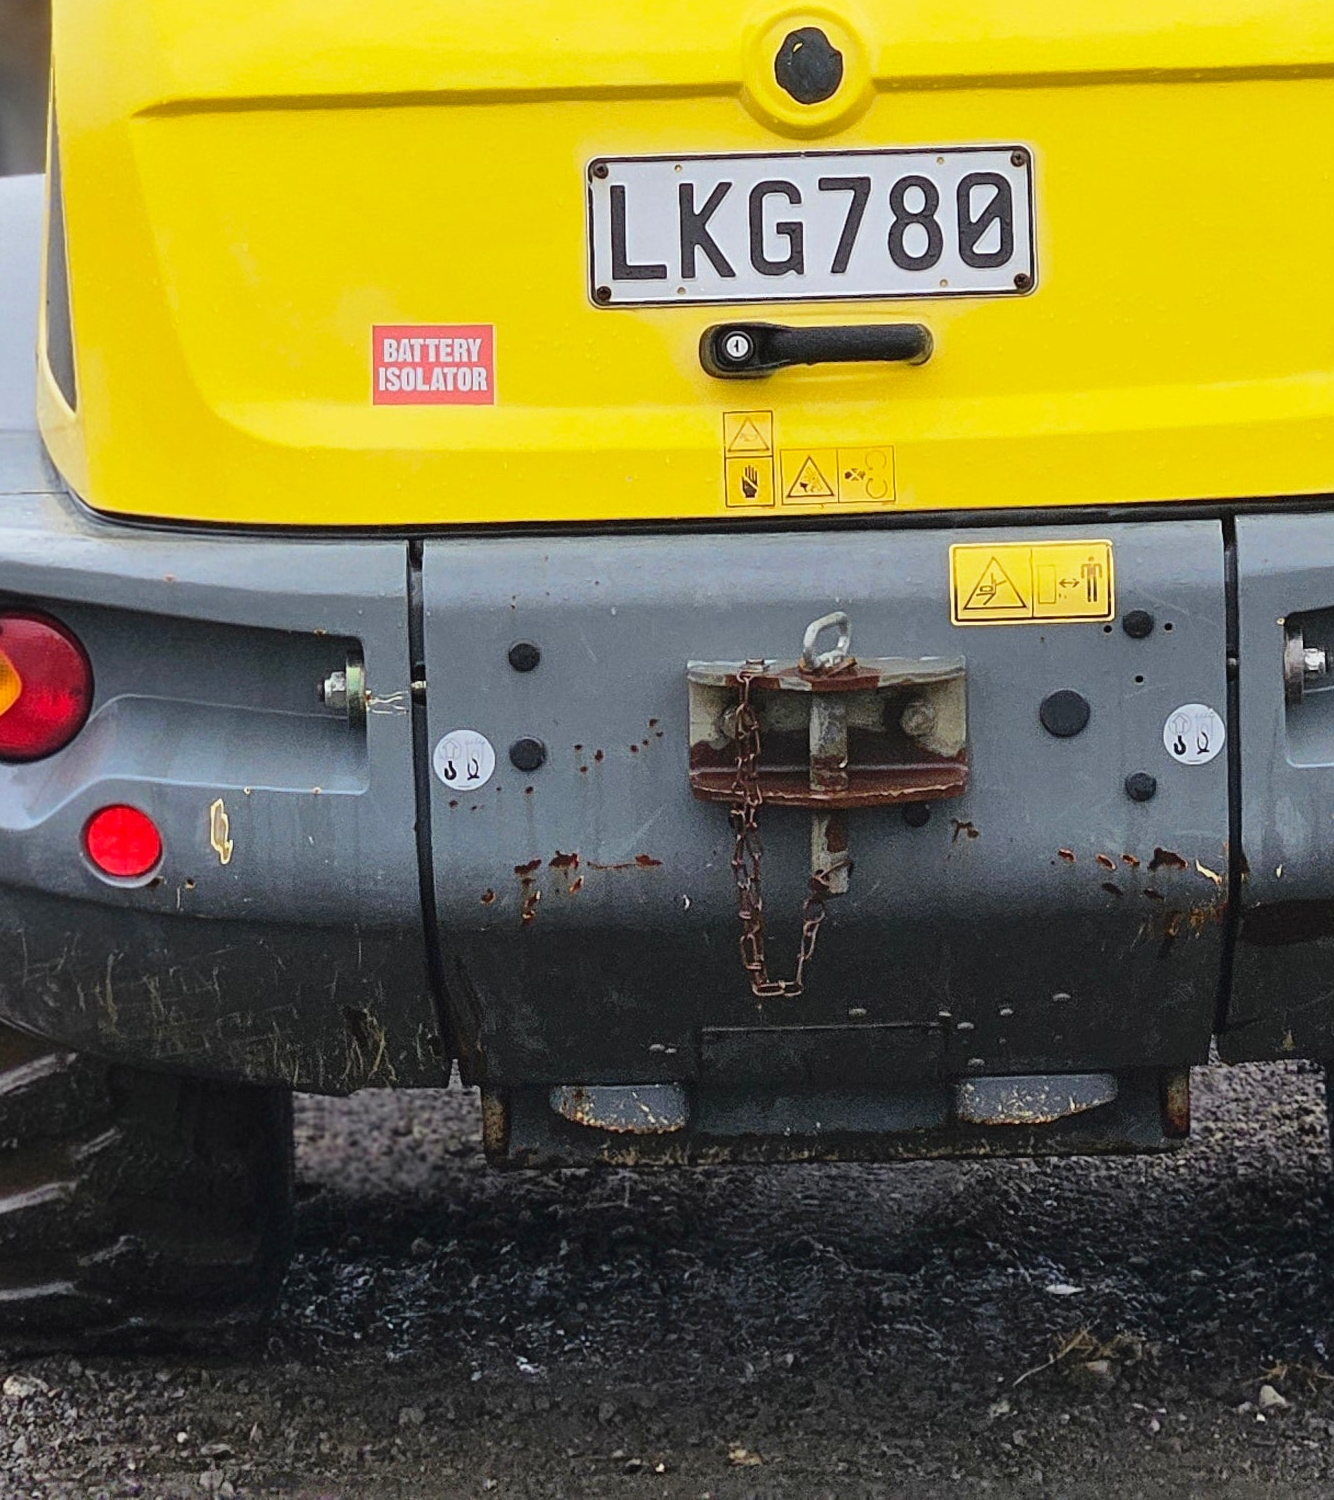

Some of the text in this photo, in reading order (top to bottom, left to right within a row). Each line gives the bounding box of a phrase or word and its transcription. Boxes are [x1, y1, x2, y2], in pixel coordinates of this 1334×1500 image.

[609, 172, 1015, 280] LKG780
[383, 338, 482, 363] BATTERY
[378, 366, 488, 392] ISOLATOR
